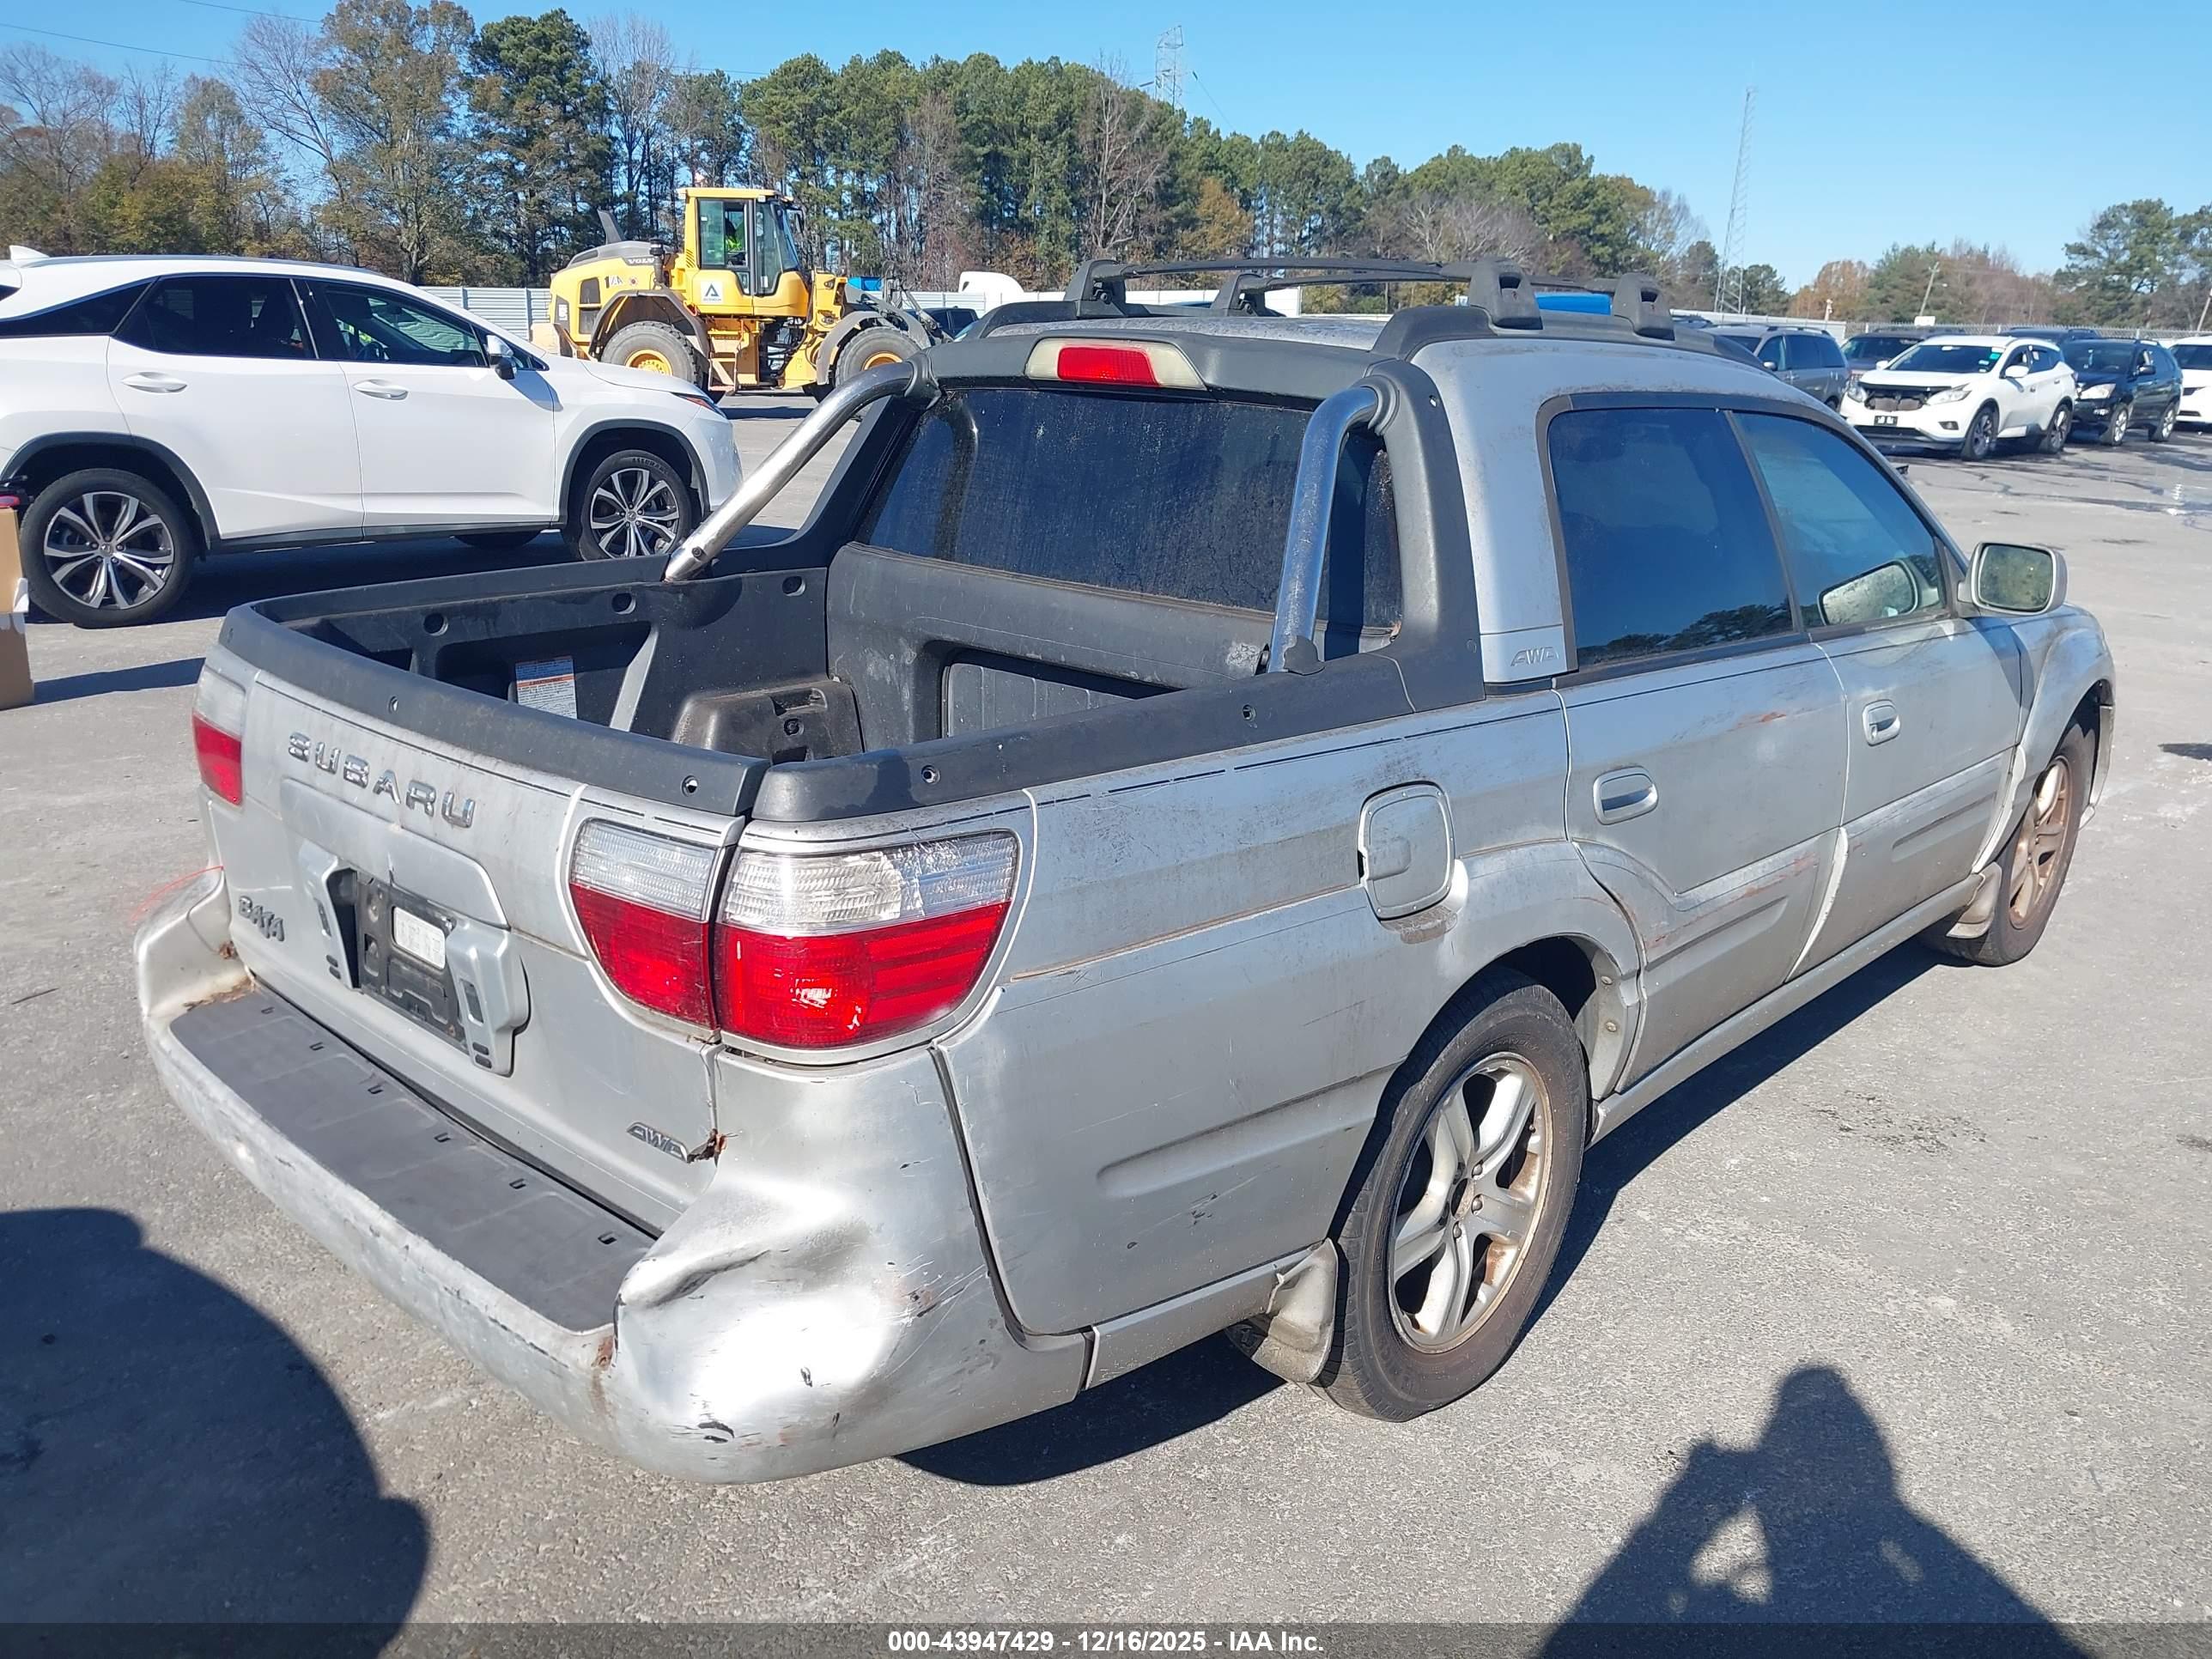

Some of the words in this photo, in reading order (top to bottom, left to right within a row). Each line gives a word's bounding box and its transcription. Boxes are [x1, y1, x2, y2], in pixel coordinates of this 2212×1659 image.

[1510, 646, 1560, 666] AWD
[289, 732, 476, 829] SUBARU
[239, 895, 285, 942] BAJA
[627, 1121, 688, 1164] AWD
